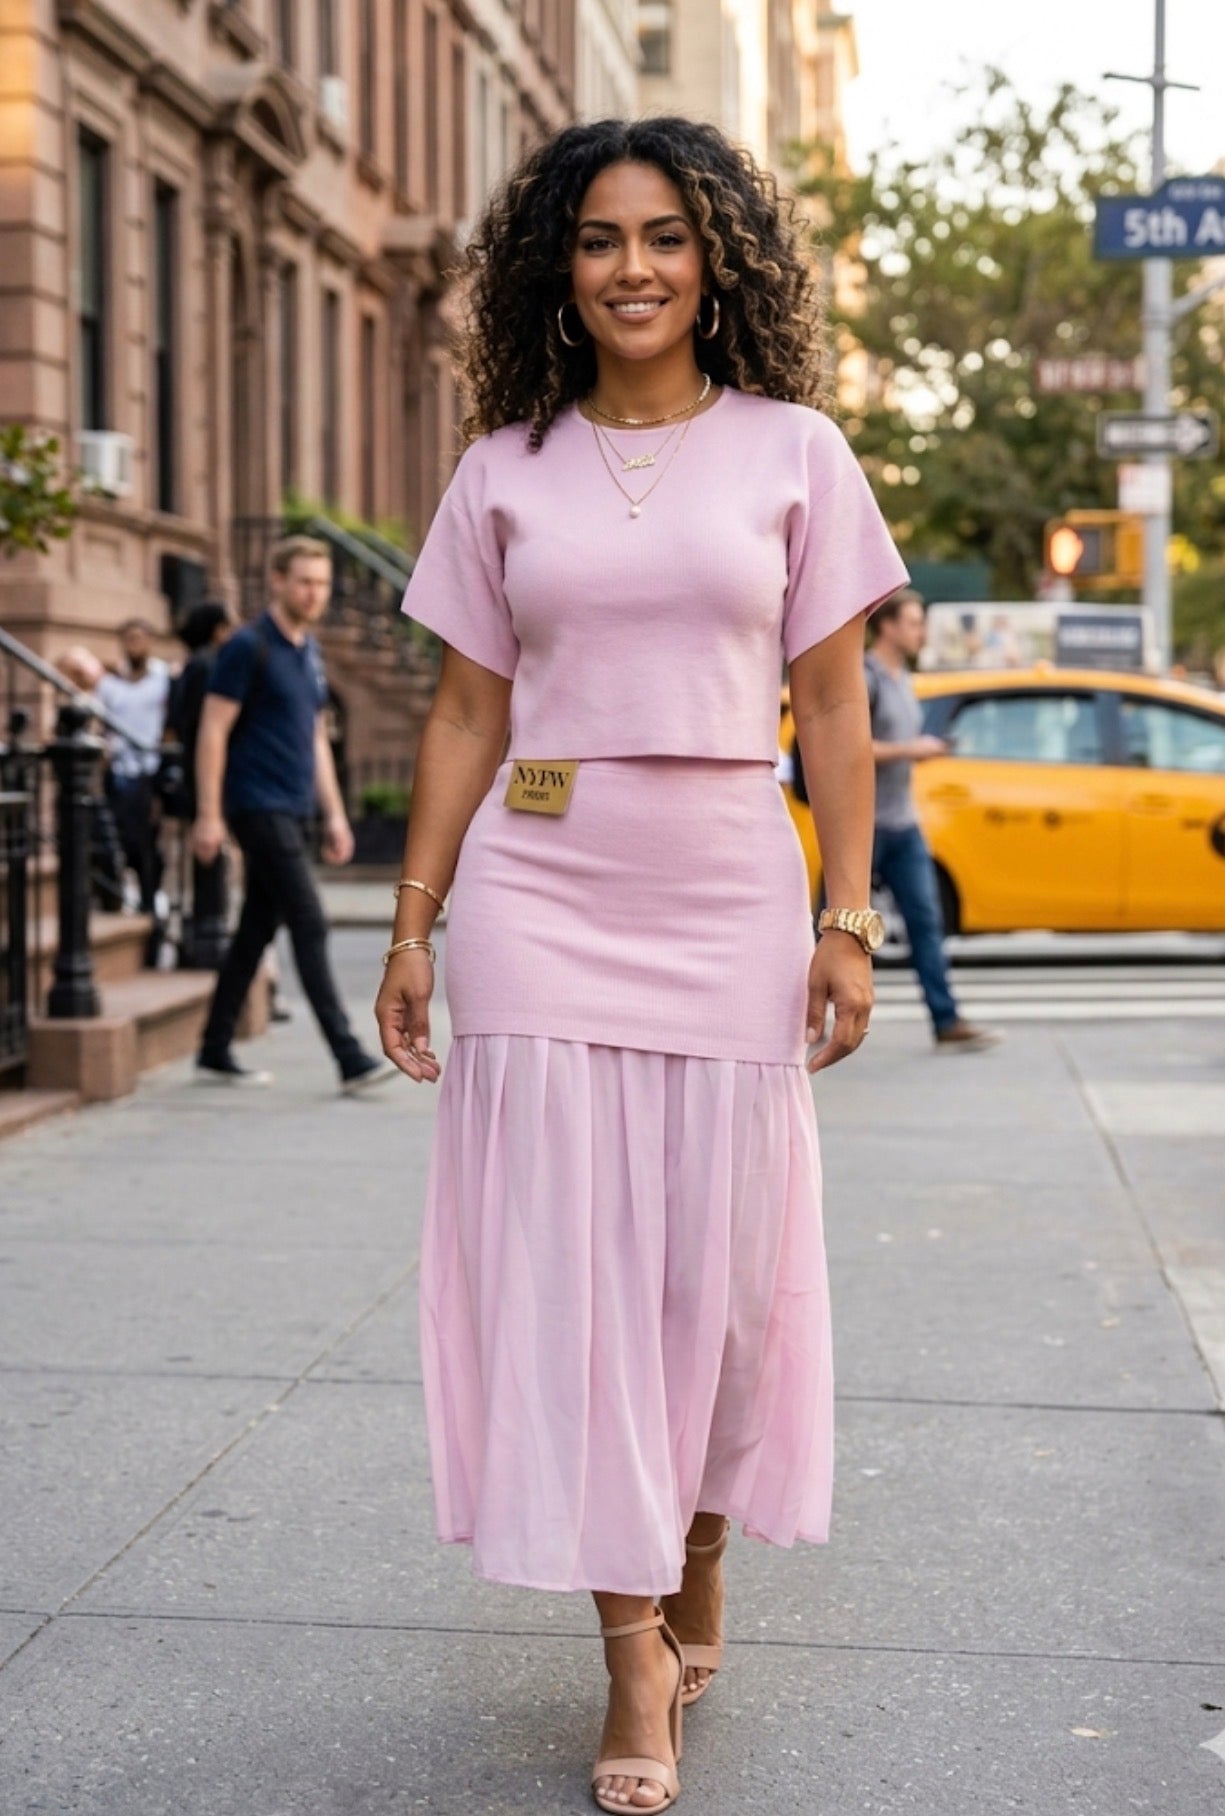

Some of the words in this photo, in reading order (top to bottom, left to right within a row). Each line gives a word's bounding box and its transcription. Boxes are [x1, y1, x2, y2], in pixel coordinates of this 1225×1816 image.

[1123, 206, 1188, 248] 5th
[1193, 207, 1225, 247] A
[513, 766, 570, 788] NYFW
